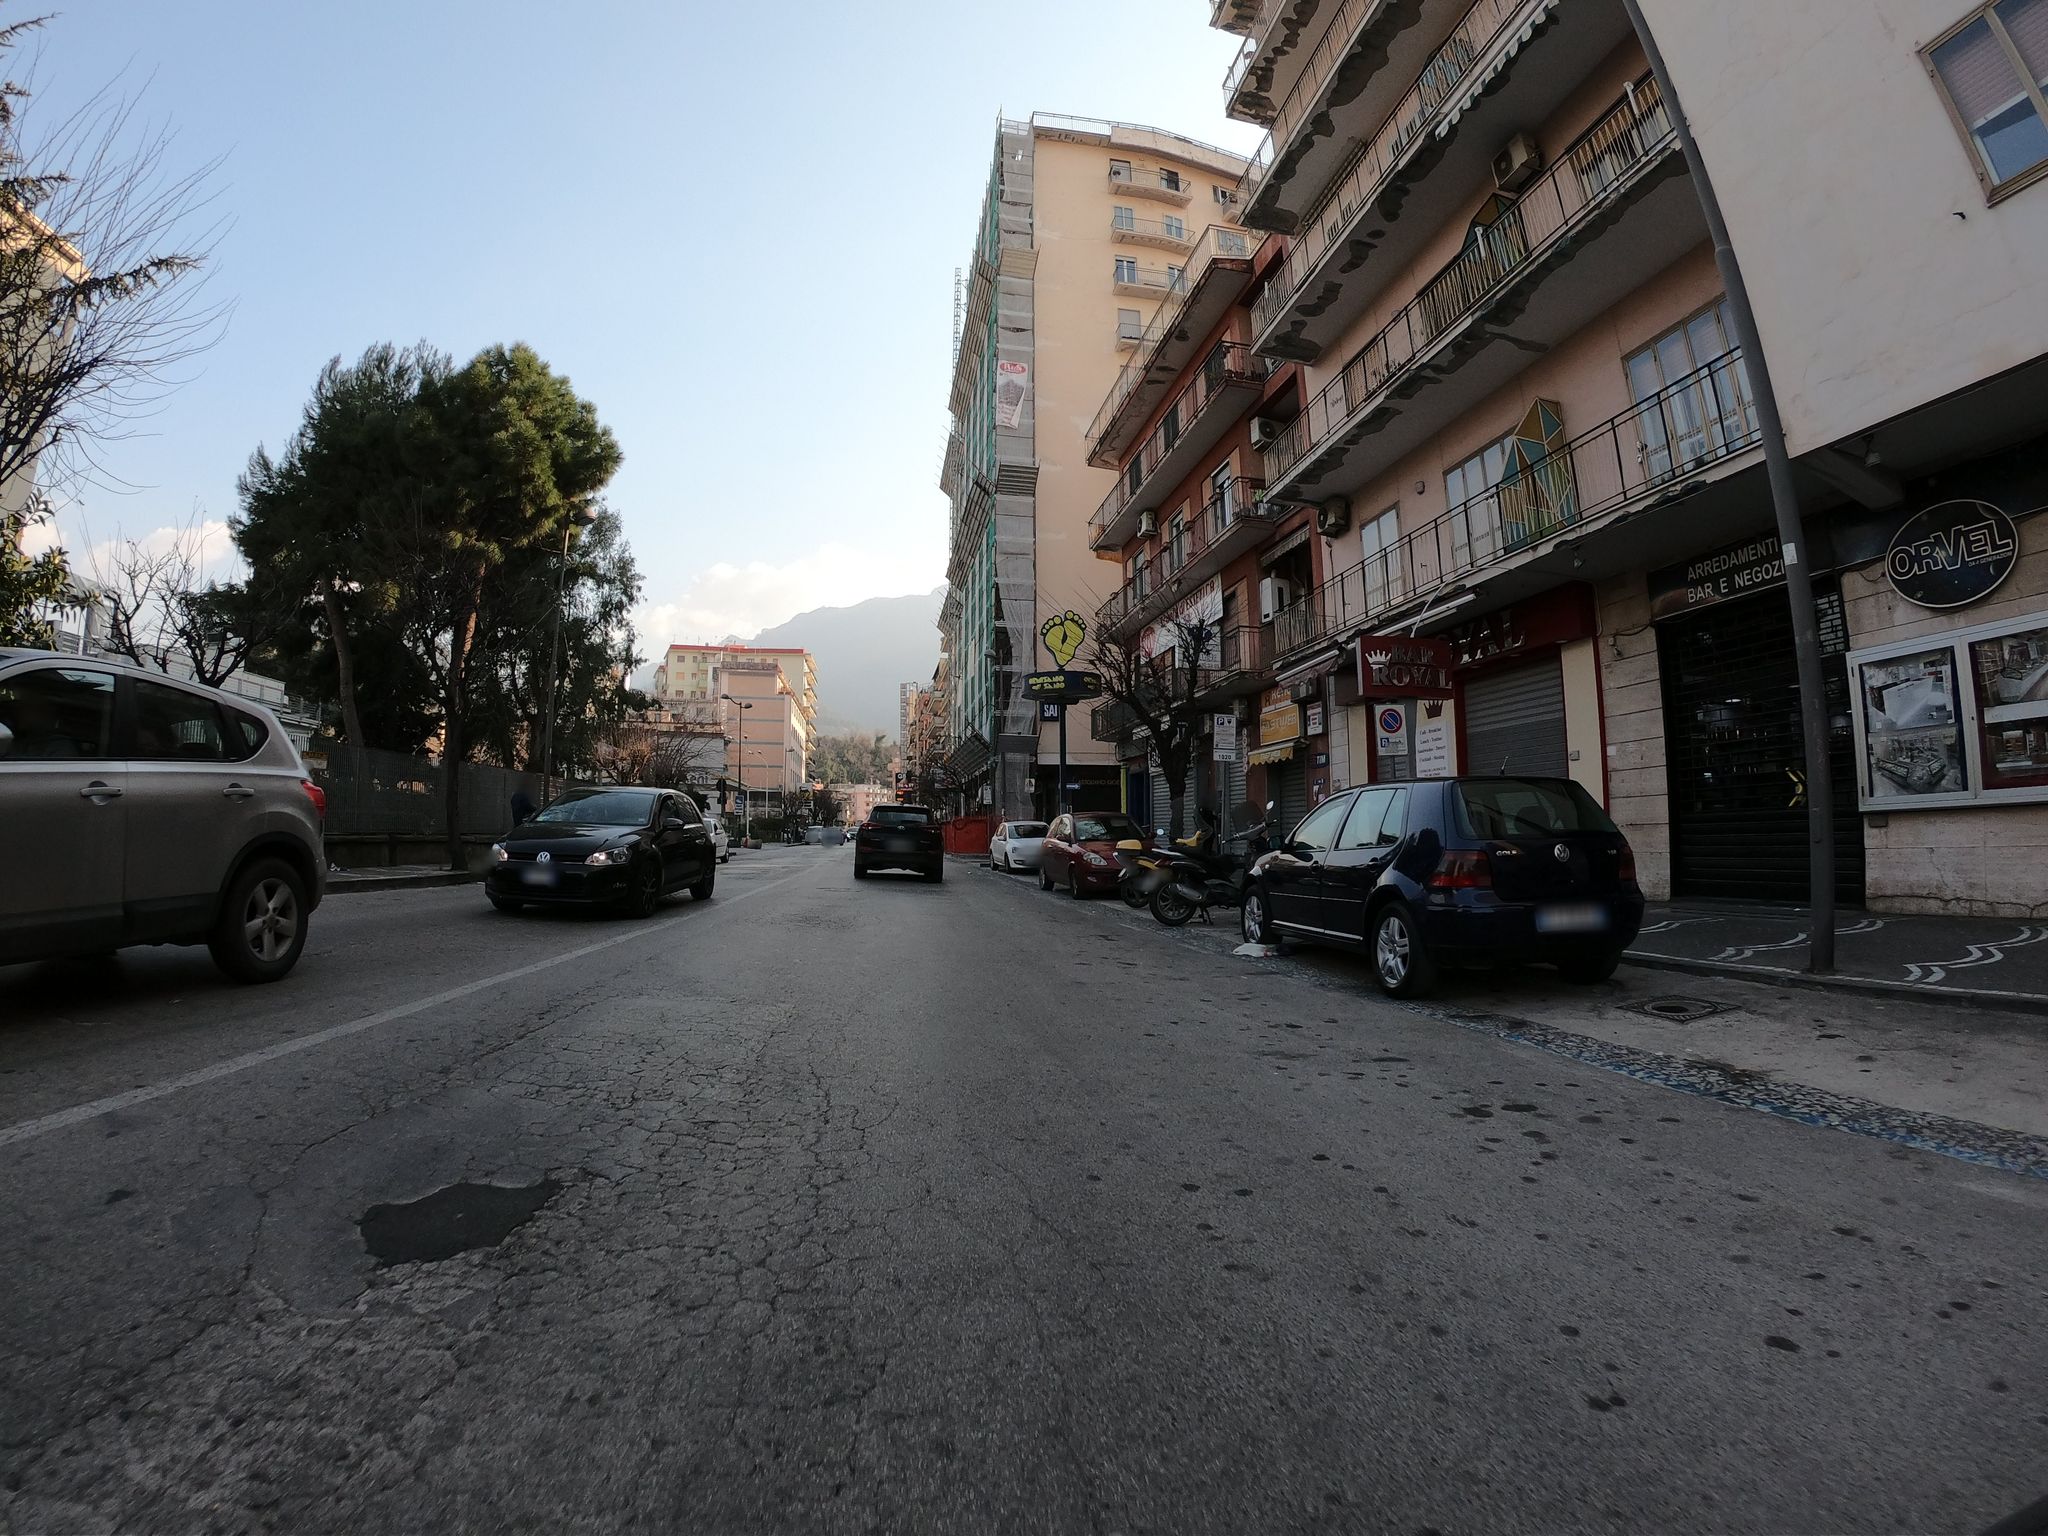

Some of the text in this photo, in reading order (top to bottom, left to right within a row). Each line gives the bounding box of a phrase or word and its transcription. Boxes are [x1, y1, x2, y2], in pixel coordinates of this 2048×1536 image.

[1687, 537, 1779, 582] ARREDAMENTI
[1888, 520, 2014, 580] ORVEL
[1687, 559, 1785, 604] BAR E NEGOZI
[1391, 644, 1434, 665] BAR
[1371, 664, 1453, 689] ROYAL
[1044, 704, 1058, 717] SAI
